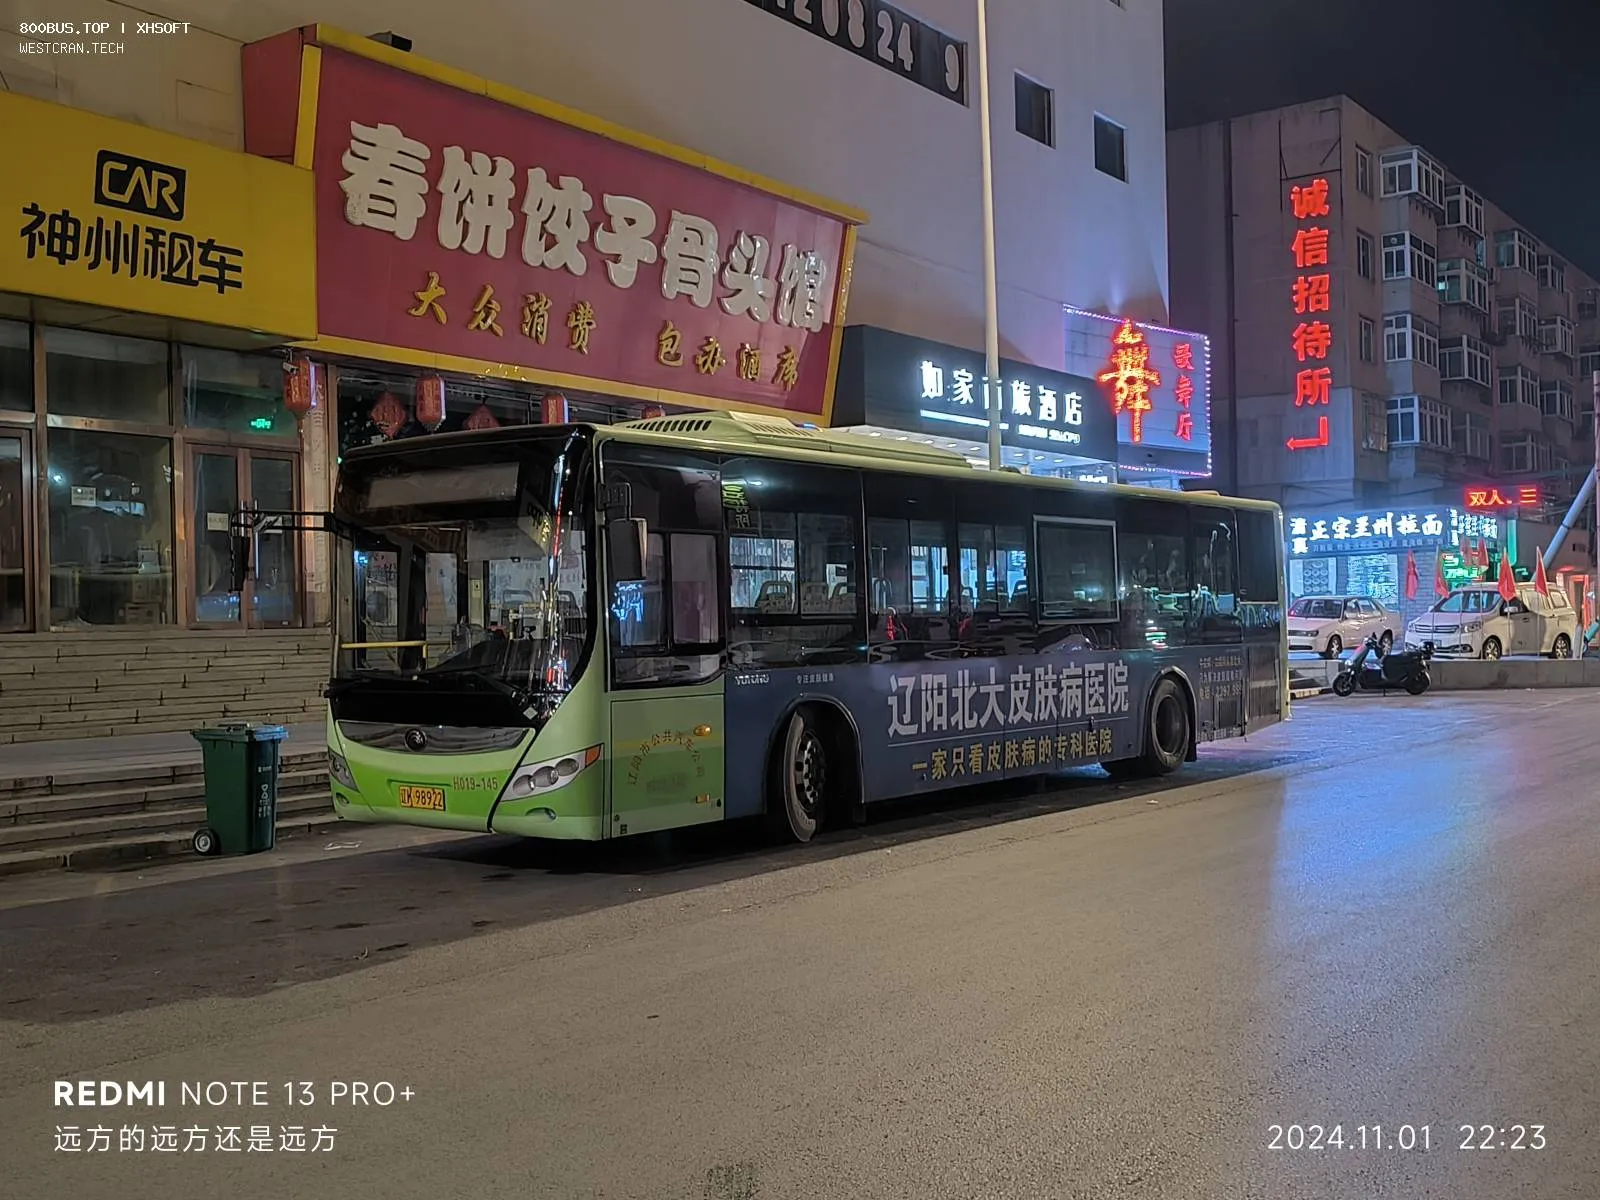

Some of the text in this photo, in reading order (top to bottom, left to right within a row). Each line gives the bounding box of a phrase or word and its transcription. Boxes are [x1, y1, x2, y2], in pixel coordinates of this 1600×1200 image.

[100, 160, 181, 214] CAR
[338, 120, 828, 333] 春饼饺子骨头馆
[20, 202, 244, 295] 神州租车
[408, 271, 801, 391] 大众消费 包办酒席
[1290, 178, 1332, 407] 诚信招待所
[1309, 511, 1443, 541] 正宗兰州拉面
[887, 659, 1129, 738] 辽阳北大皮肤病医院
[452, 776, 498, 791] H019-145
[912, 727, 1113, 780] 一家只看皮肤病的专科医院
